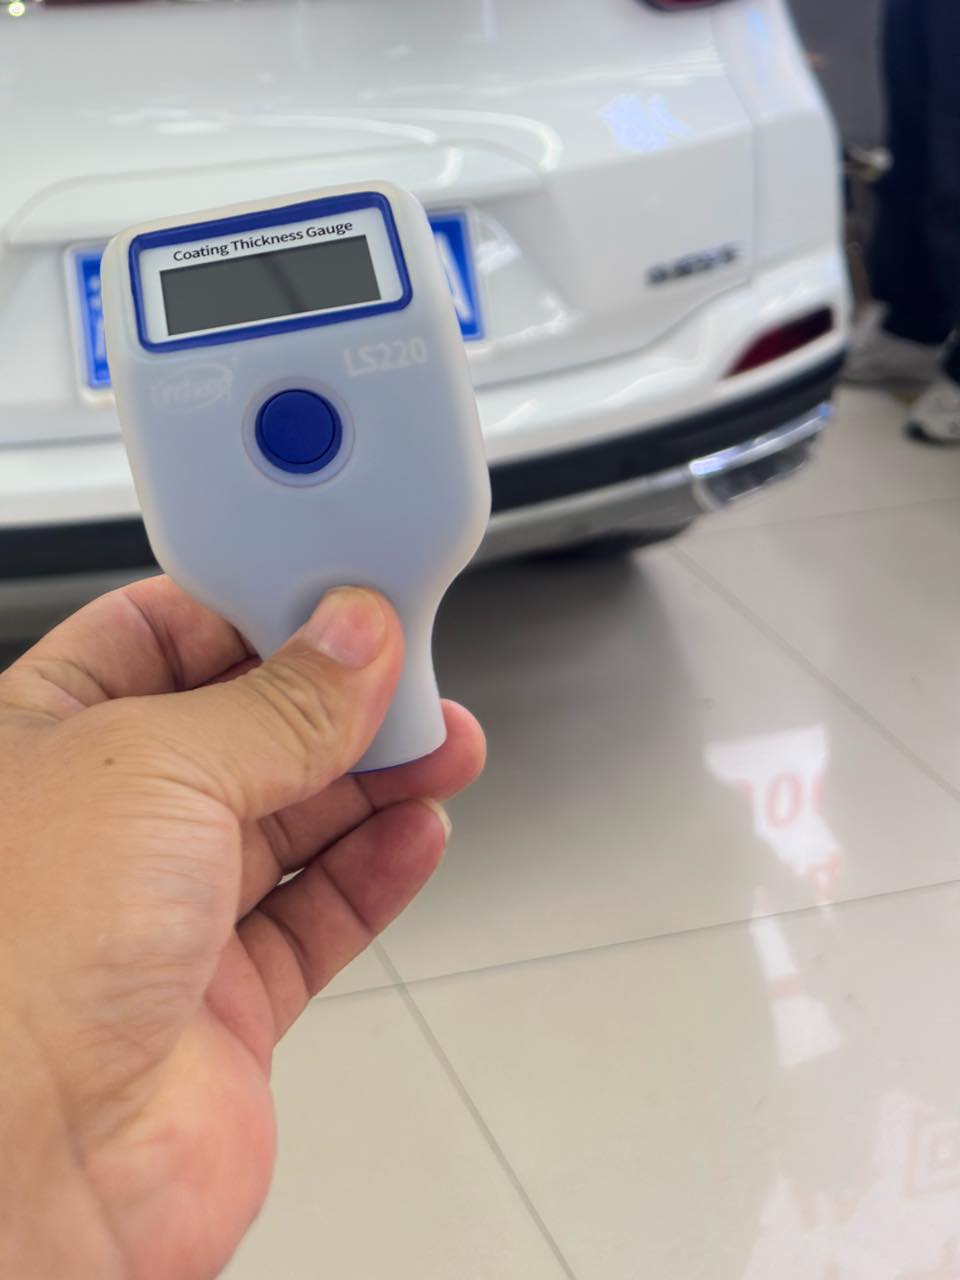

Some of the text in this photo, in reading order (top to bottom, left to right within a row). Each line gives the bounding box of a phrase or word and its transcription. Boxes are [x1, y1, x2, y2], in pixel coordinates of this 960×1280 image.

[173, 221, 353, 262] Coating Thickness Gauge
[343, 337, 427, 376] LS220
